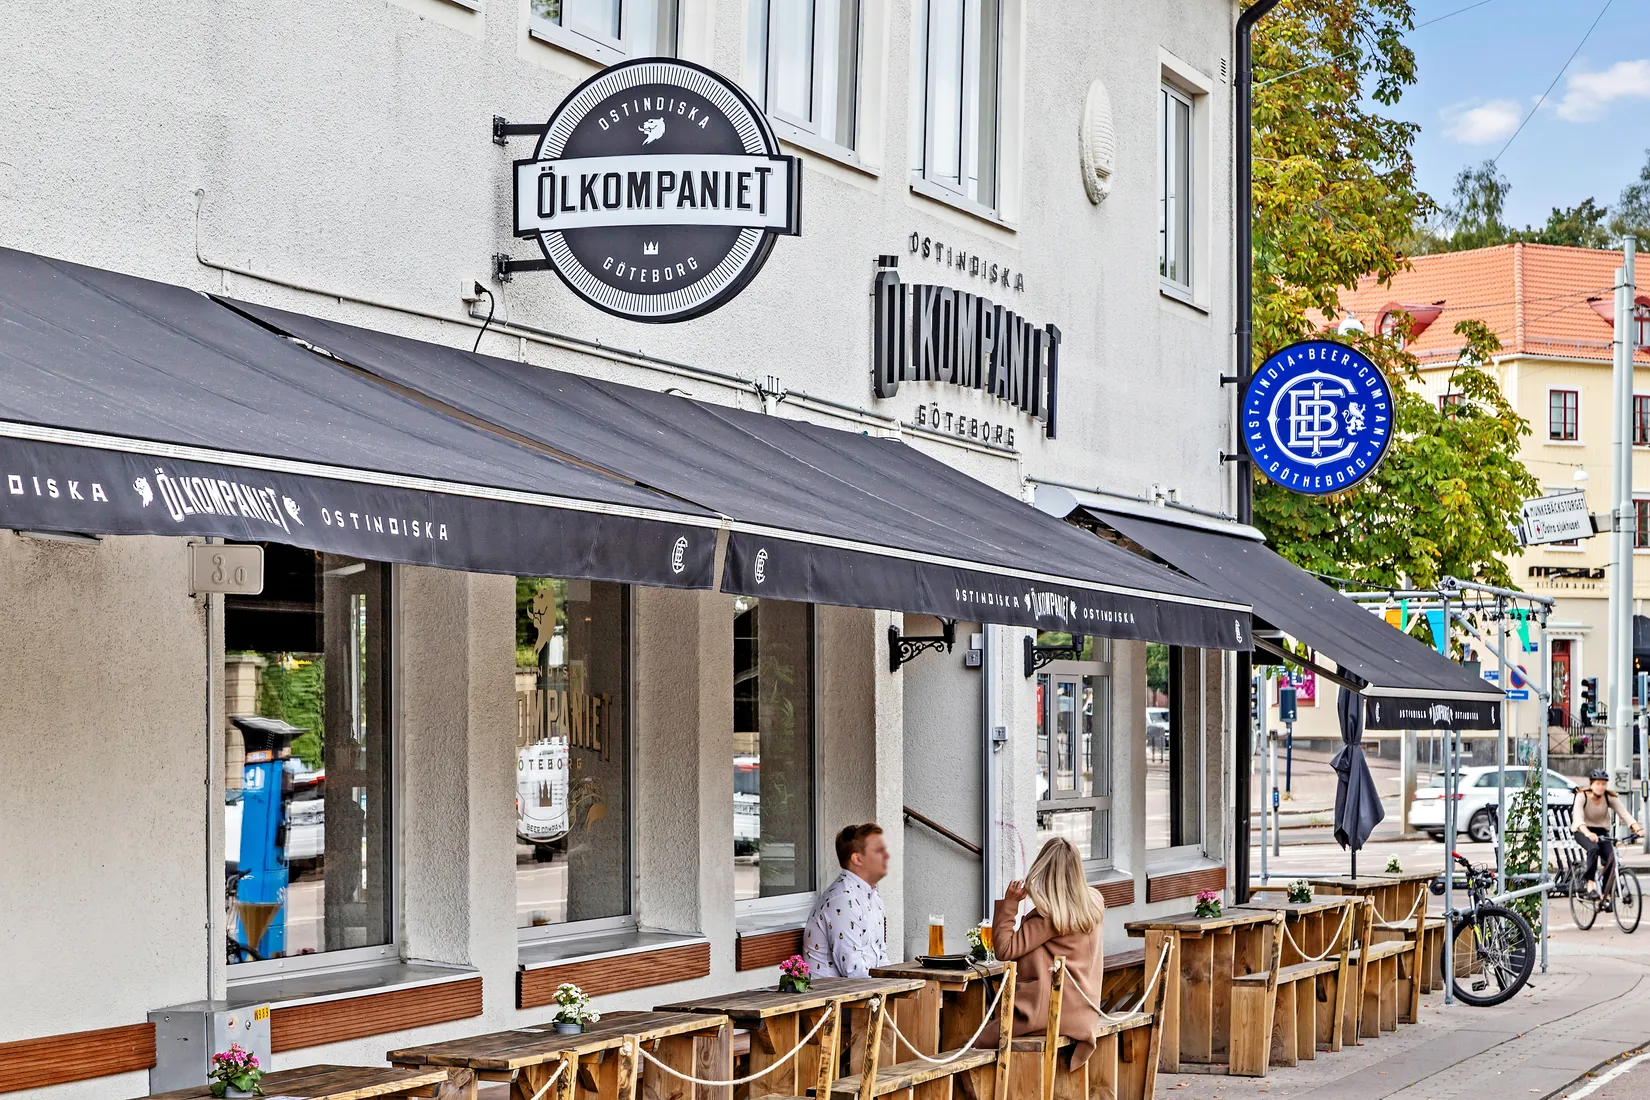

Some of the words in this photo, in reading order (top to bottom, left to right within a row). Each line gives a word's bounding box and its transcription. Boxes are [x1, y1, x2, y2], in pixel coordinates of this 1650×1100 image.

[598, 97, 711, 131] OSTINDISKA
[537, 166, 773, 219] ÖLKOMPANIET
[603, 256, 698, 283] GÖTEBORG
[909, 231, 1025, 293] OSTINDISKA
[874, 254, 1062, 440] ÖLKOMPANIET
[1308, 348, 1350, 365] BEER
[1255, 355, 1296, 396] INDIA
[915, 401, 1015, 447] GÖTEBORG
[1358, 367, 1386, 448] COMPANY
[1249, 409, 1266, 452] EAST
[1269, 458, 1366, 488] GÖTHEBORG
[8, 474, 108, 502] DISKA
[154, 467, 291, 535] ÖLKOMPANIET
[321, 507, 448, 540] OSTINDISKA
[1530, 498, 1584, 517] MUNKEBÄCKSTORGET
[1556, 519, 1580, 534] sjukhuset
[211, 553, 248, 585] 3.0
[955, 588, 1020, 608] OSTINDISKA
[1083, 608, 1135, 624] OSTINDISKA
